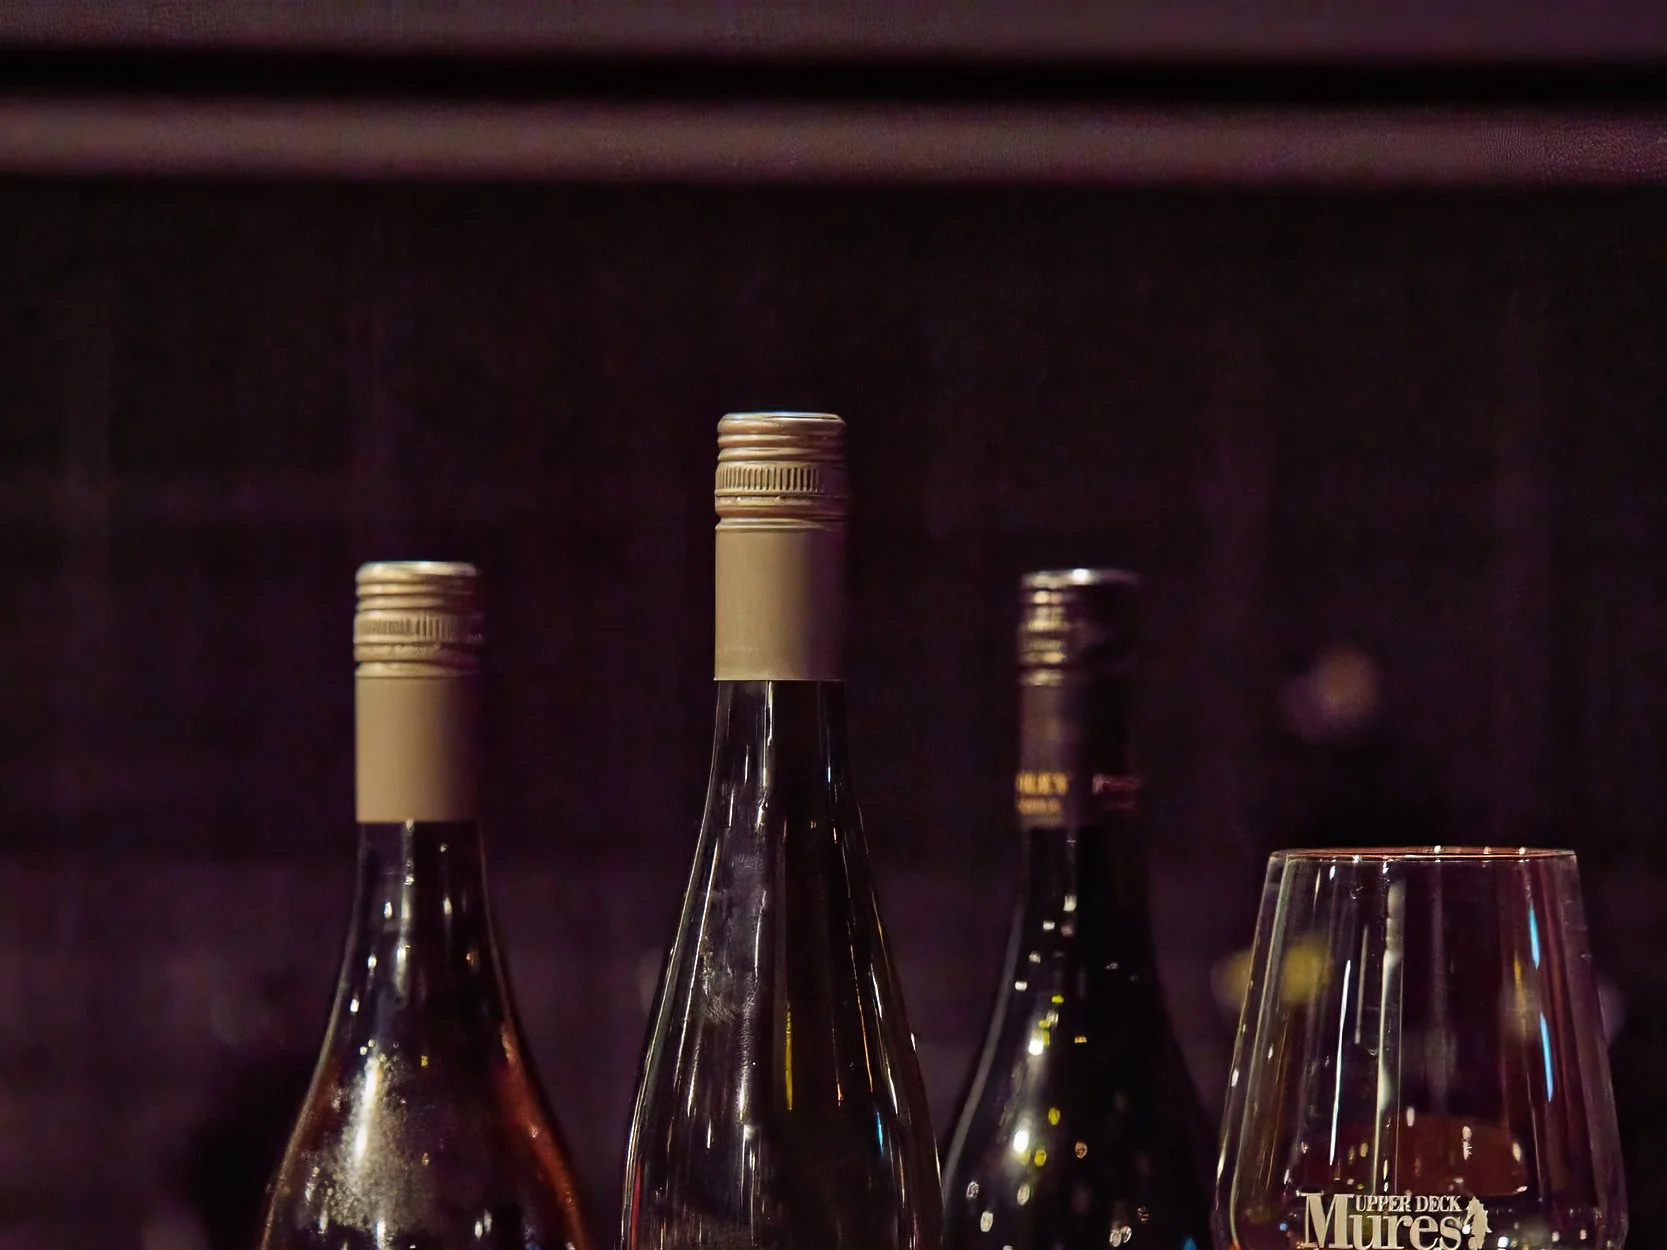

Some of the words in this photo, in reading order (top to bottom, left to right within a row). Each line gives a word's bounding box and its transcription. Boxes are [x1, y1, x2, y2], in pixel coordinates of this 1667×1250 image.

[1299, 1191, 1463, 1250] Mures
[1355, 1195, 1411, 1212] UPPER
[1415, 1195, 1462, 1212] DECK
